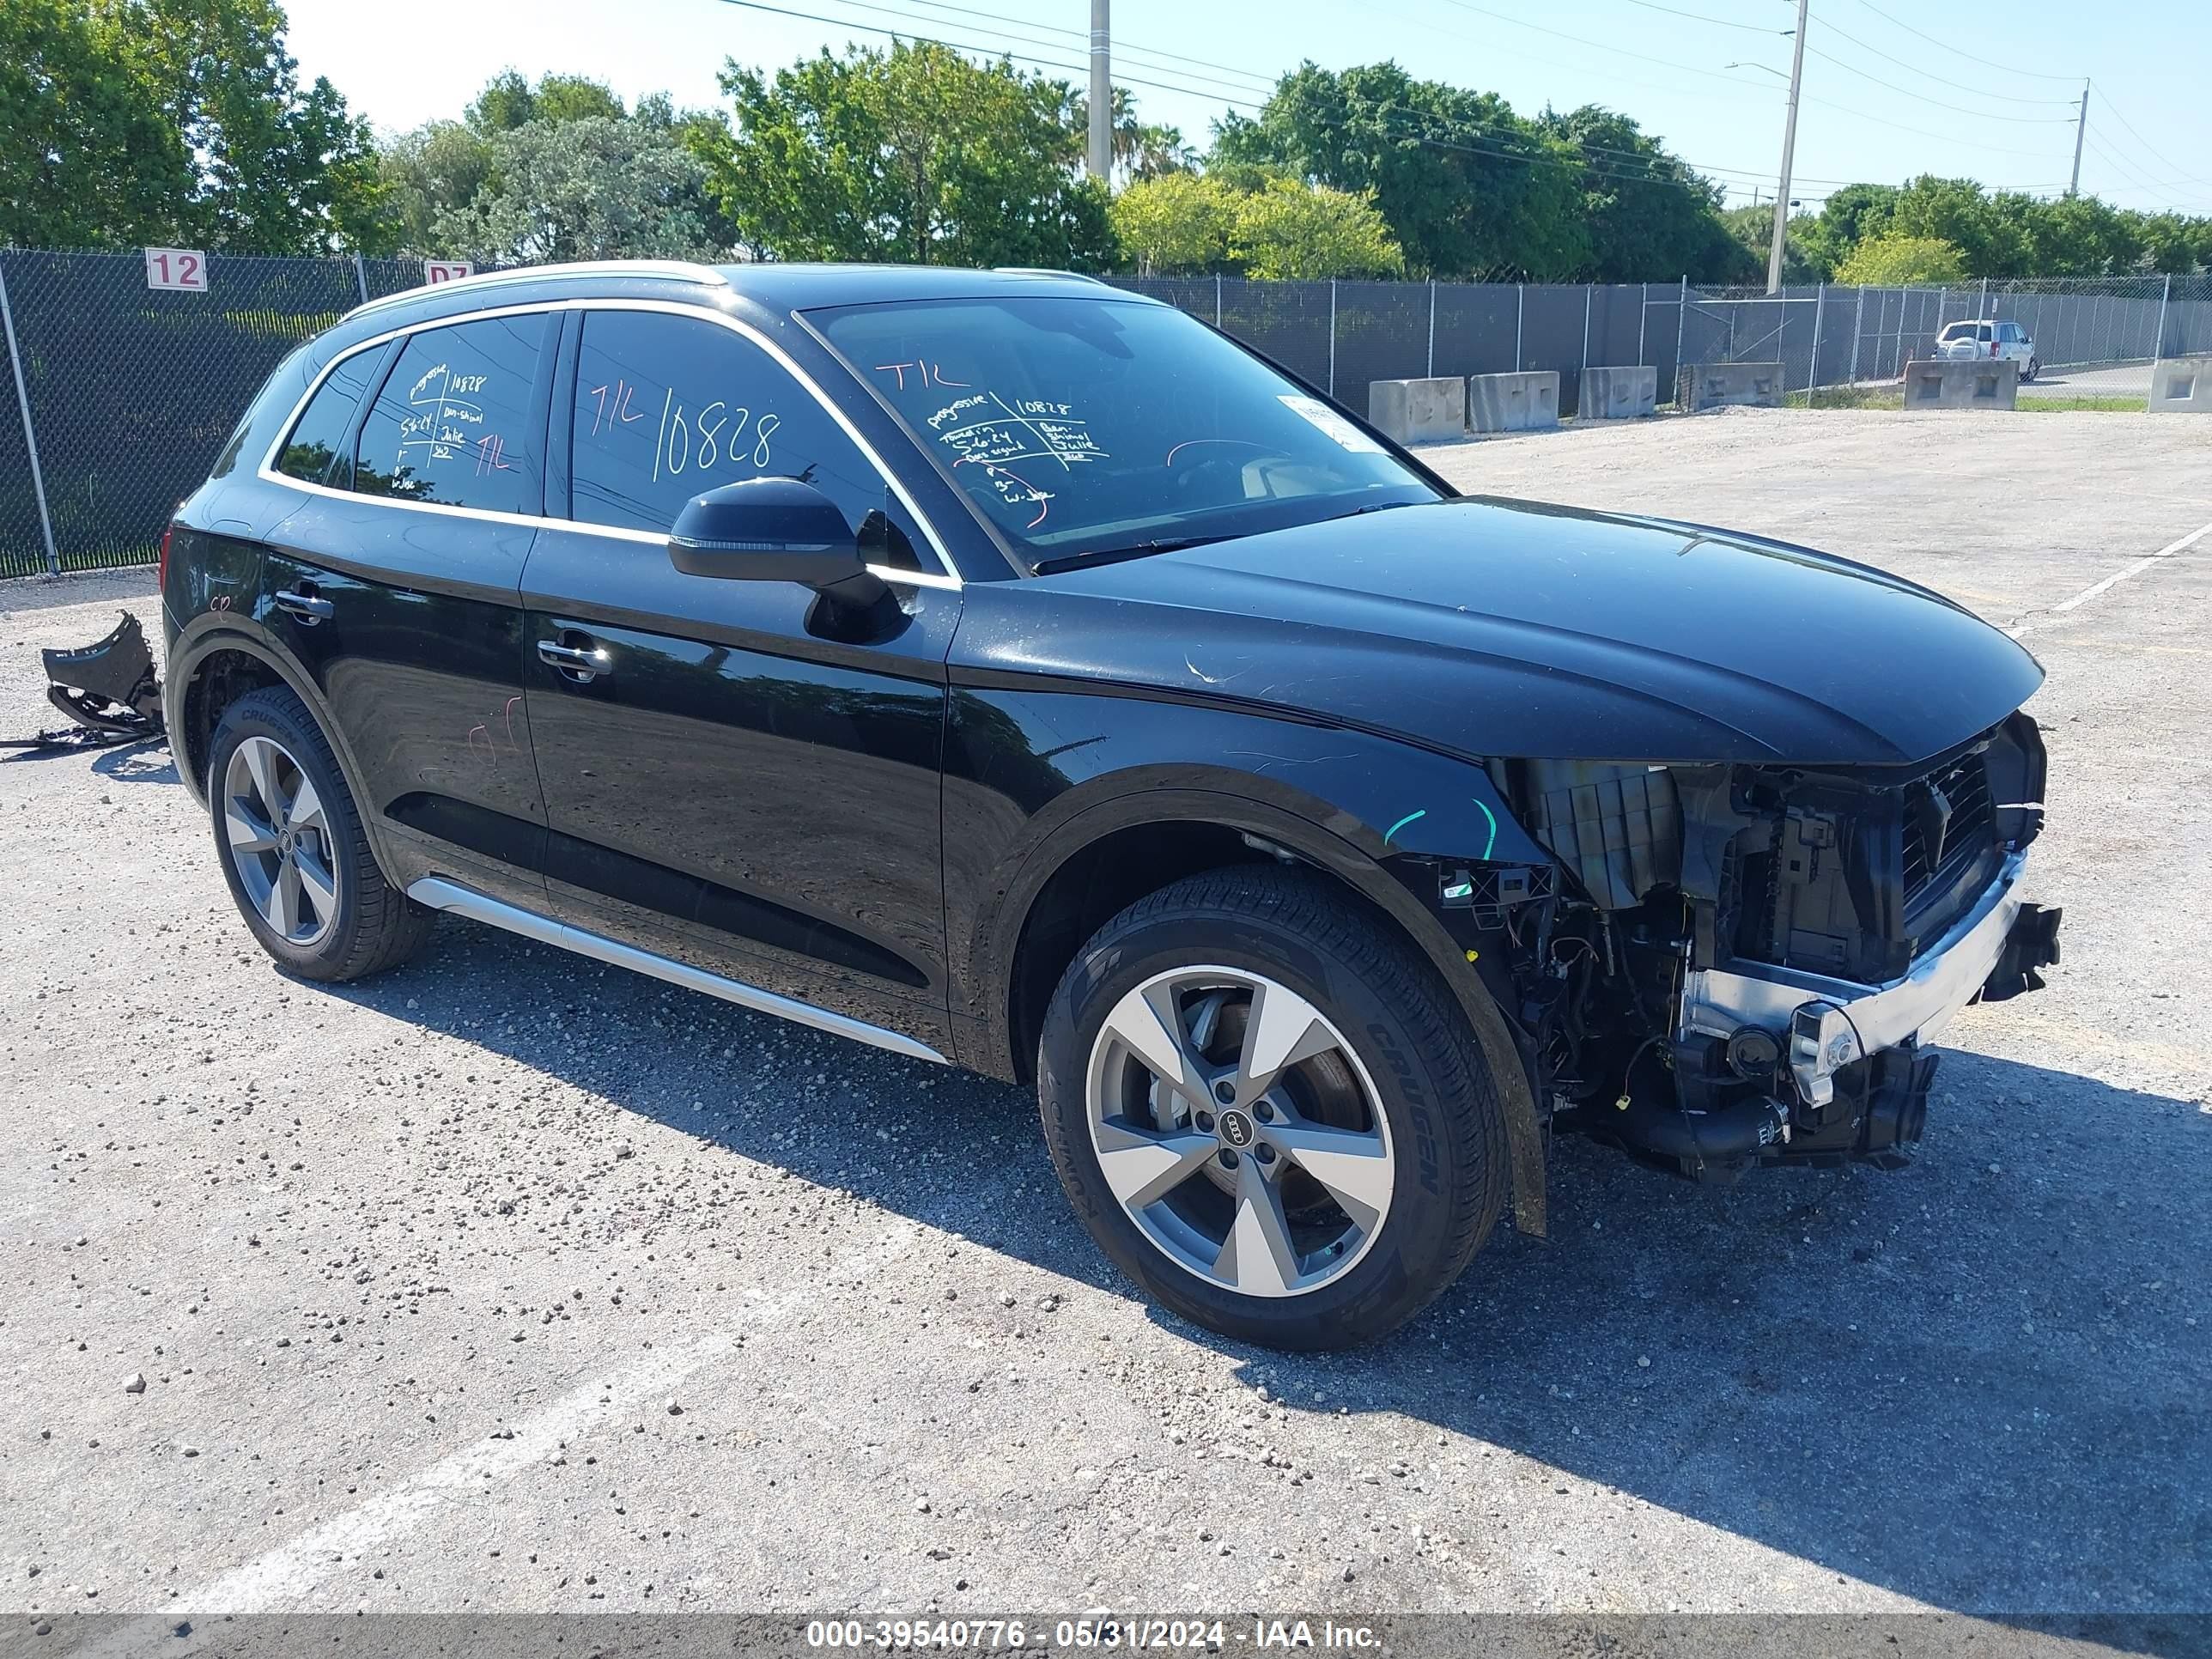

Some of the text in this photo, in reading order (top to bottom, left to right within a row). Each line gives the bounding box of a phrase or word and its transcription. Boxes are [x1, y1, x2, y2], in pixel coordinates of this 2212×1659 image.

[153, 254, 199, 285] 12
[450, 373, 488, 393] 10828
[1016, 398, 1073, 416] 10828
[441, 425, 466, 444] Julie
[653, 386, 781, 483] 10828
[1366, 1022, 1439, 1197] CRUGEN
